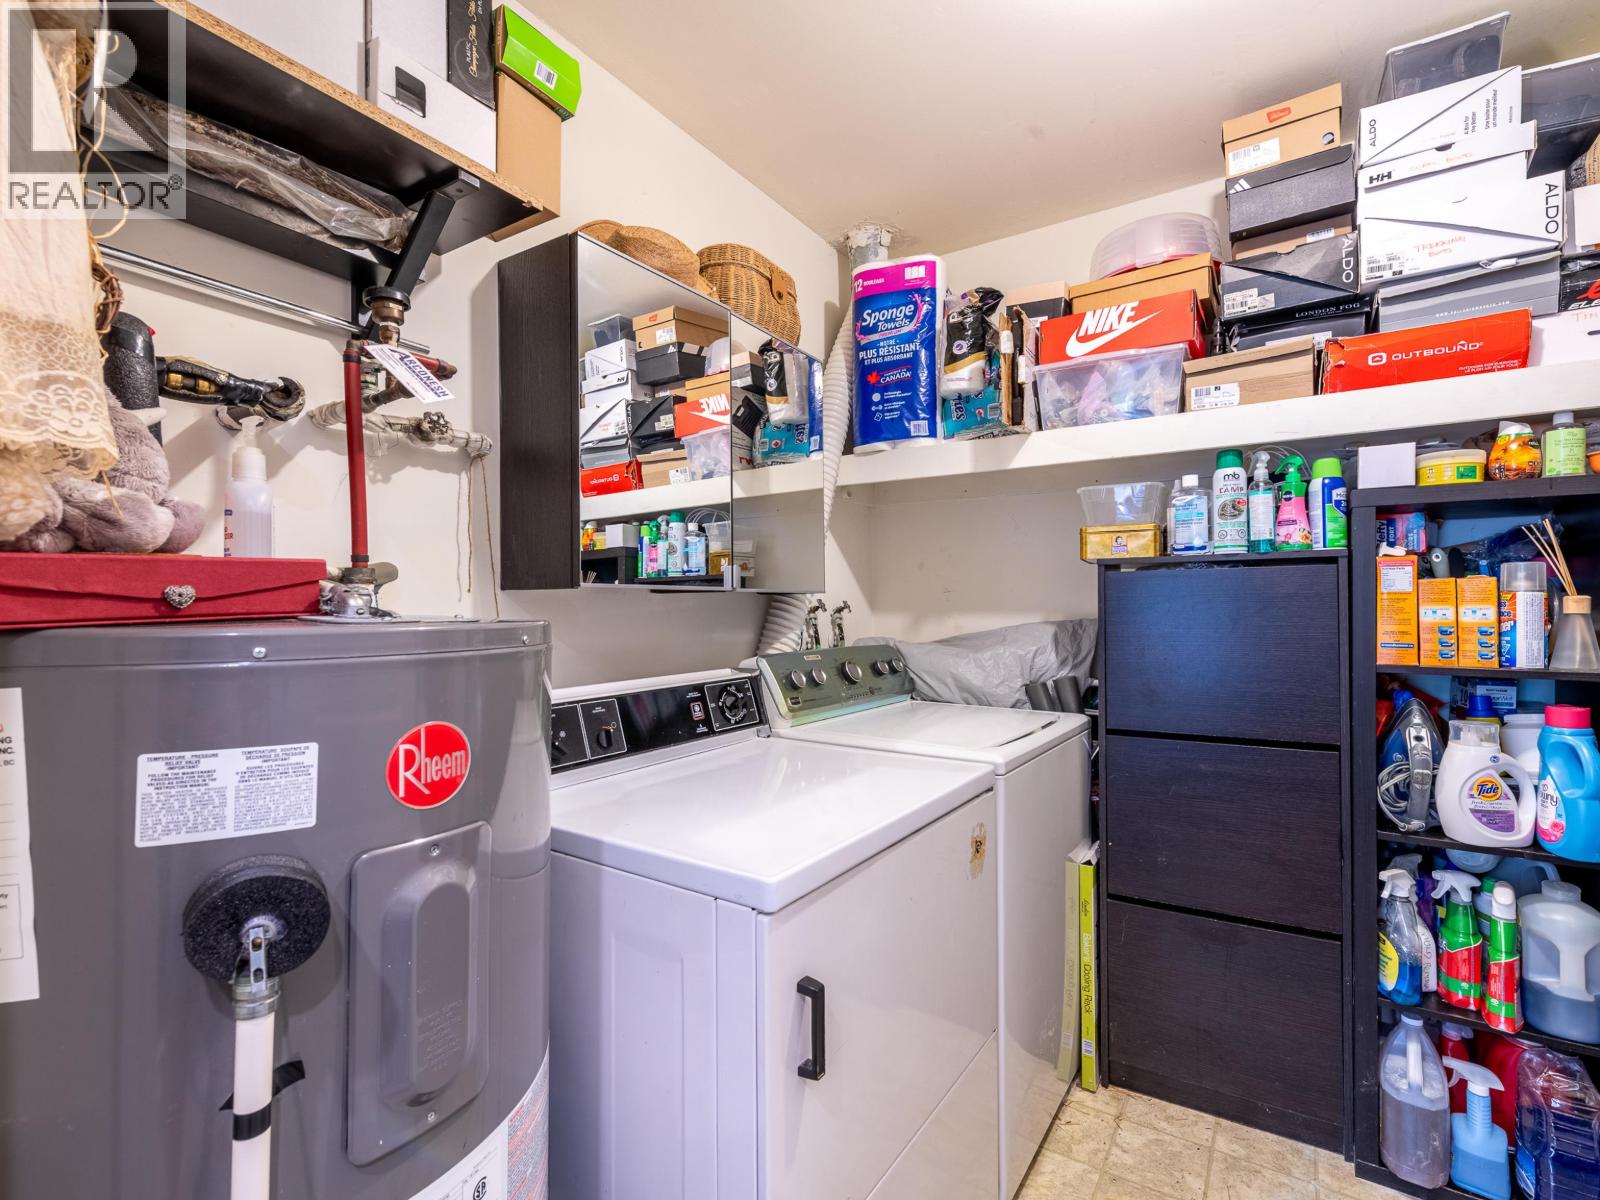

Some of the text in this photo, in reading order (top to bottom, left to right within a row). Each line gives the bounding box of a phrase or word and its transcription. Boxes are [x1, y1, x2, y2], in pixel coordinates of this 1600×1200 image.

[1369, 118, 1378, 147] ALDO
[1369, 171, 1392, 184] HH
[1545, 183, 1560, 234] ALDO
[1342, 238, 1354, 283] ALDO
[854, 279, 864, 293] 12
[862, 304, 915, 328] Sponge
[1078, 301, 1140, 337] NIKE
[1295, 305, 1337, 318] LONDON
[1339, 302, 1361, 312] FOG
[877, 317, 911, 332] Towels
[859, 348, 878, 361] PLUS
[1391, 340, 1482, 361] OUTBOUND
[880, 372, 909, 383] CANADA
[1223, 472, 1240, 481] mb
[398, 727, 466, 798] Rheem
[1477, 784, 1500, 797] Tide
[1082, 963, 1093, 993] Cooling
[1083, 994, 1093, 1015] Rack
